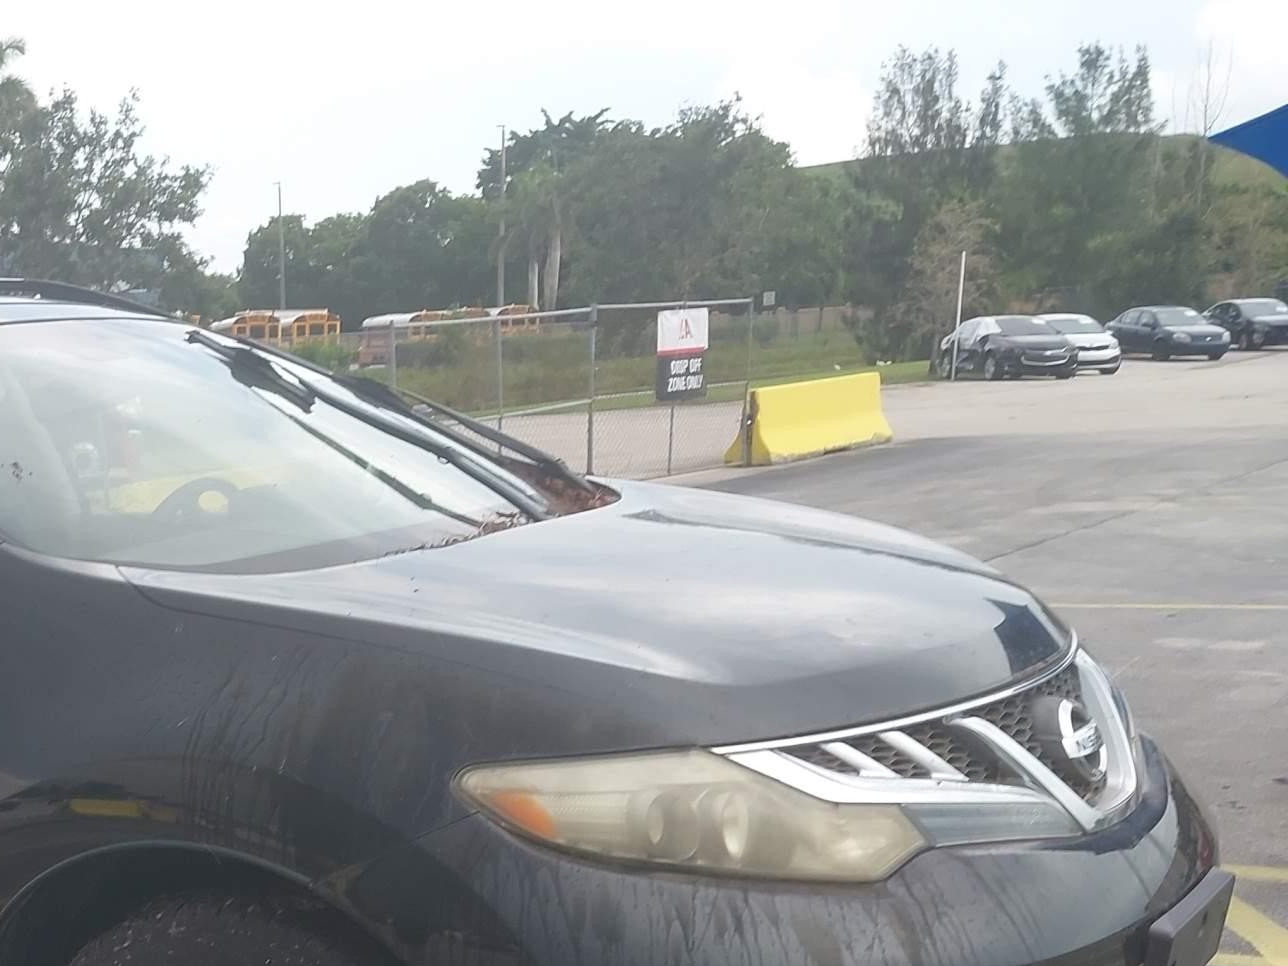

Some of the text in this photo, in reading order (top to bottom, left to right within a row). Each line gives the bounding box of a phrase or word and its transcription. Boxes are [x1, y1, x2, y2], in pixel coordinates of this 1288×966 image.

[689, 358, 703, 373] OFF
[667, 374, 704, 392] ZONE ONLY
